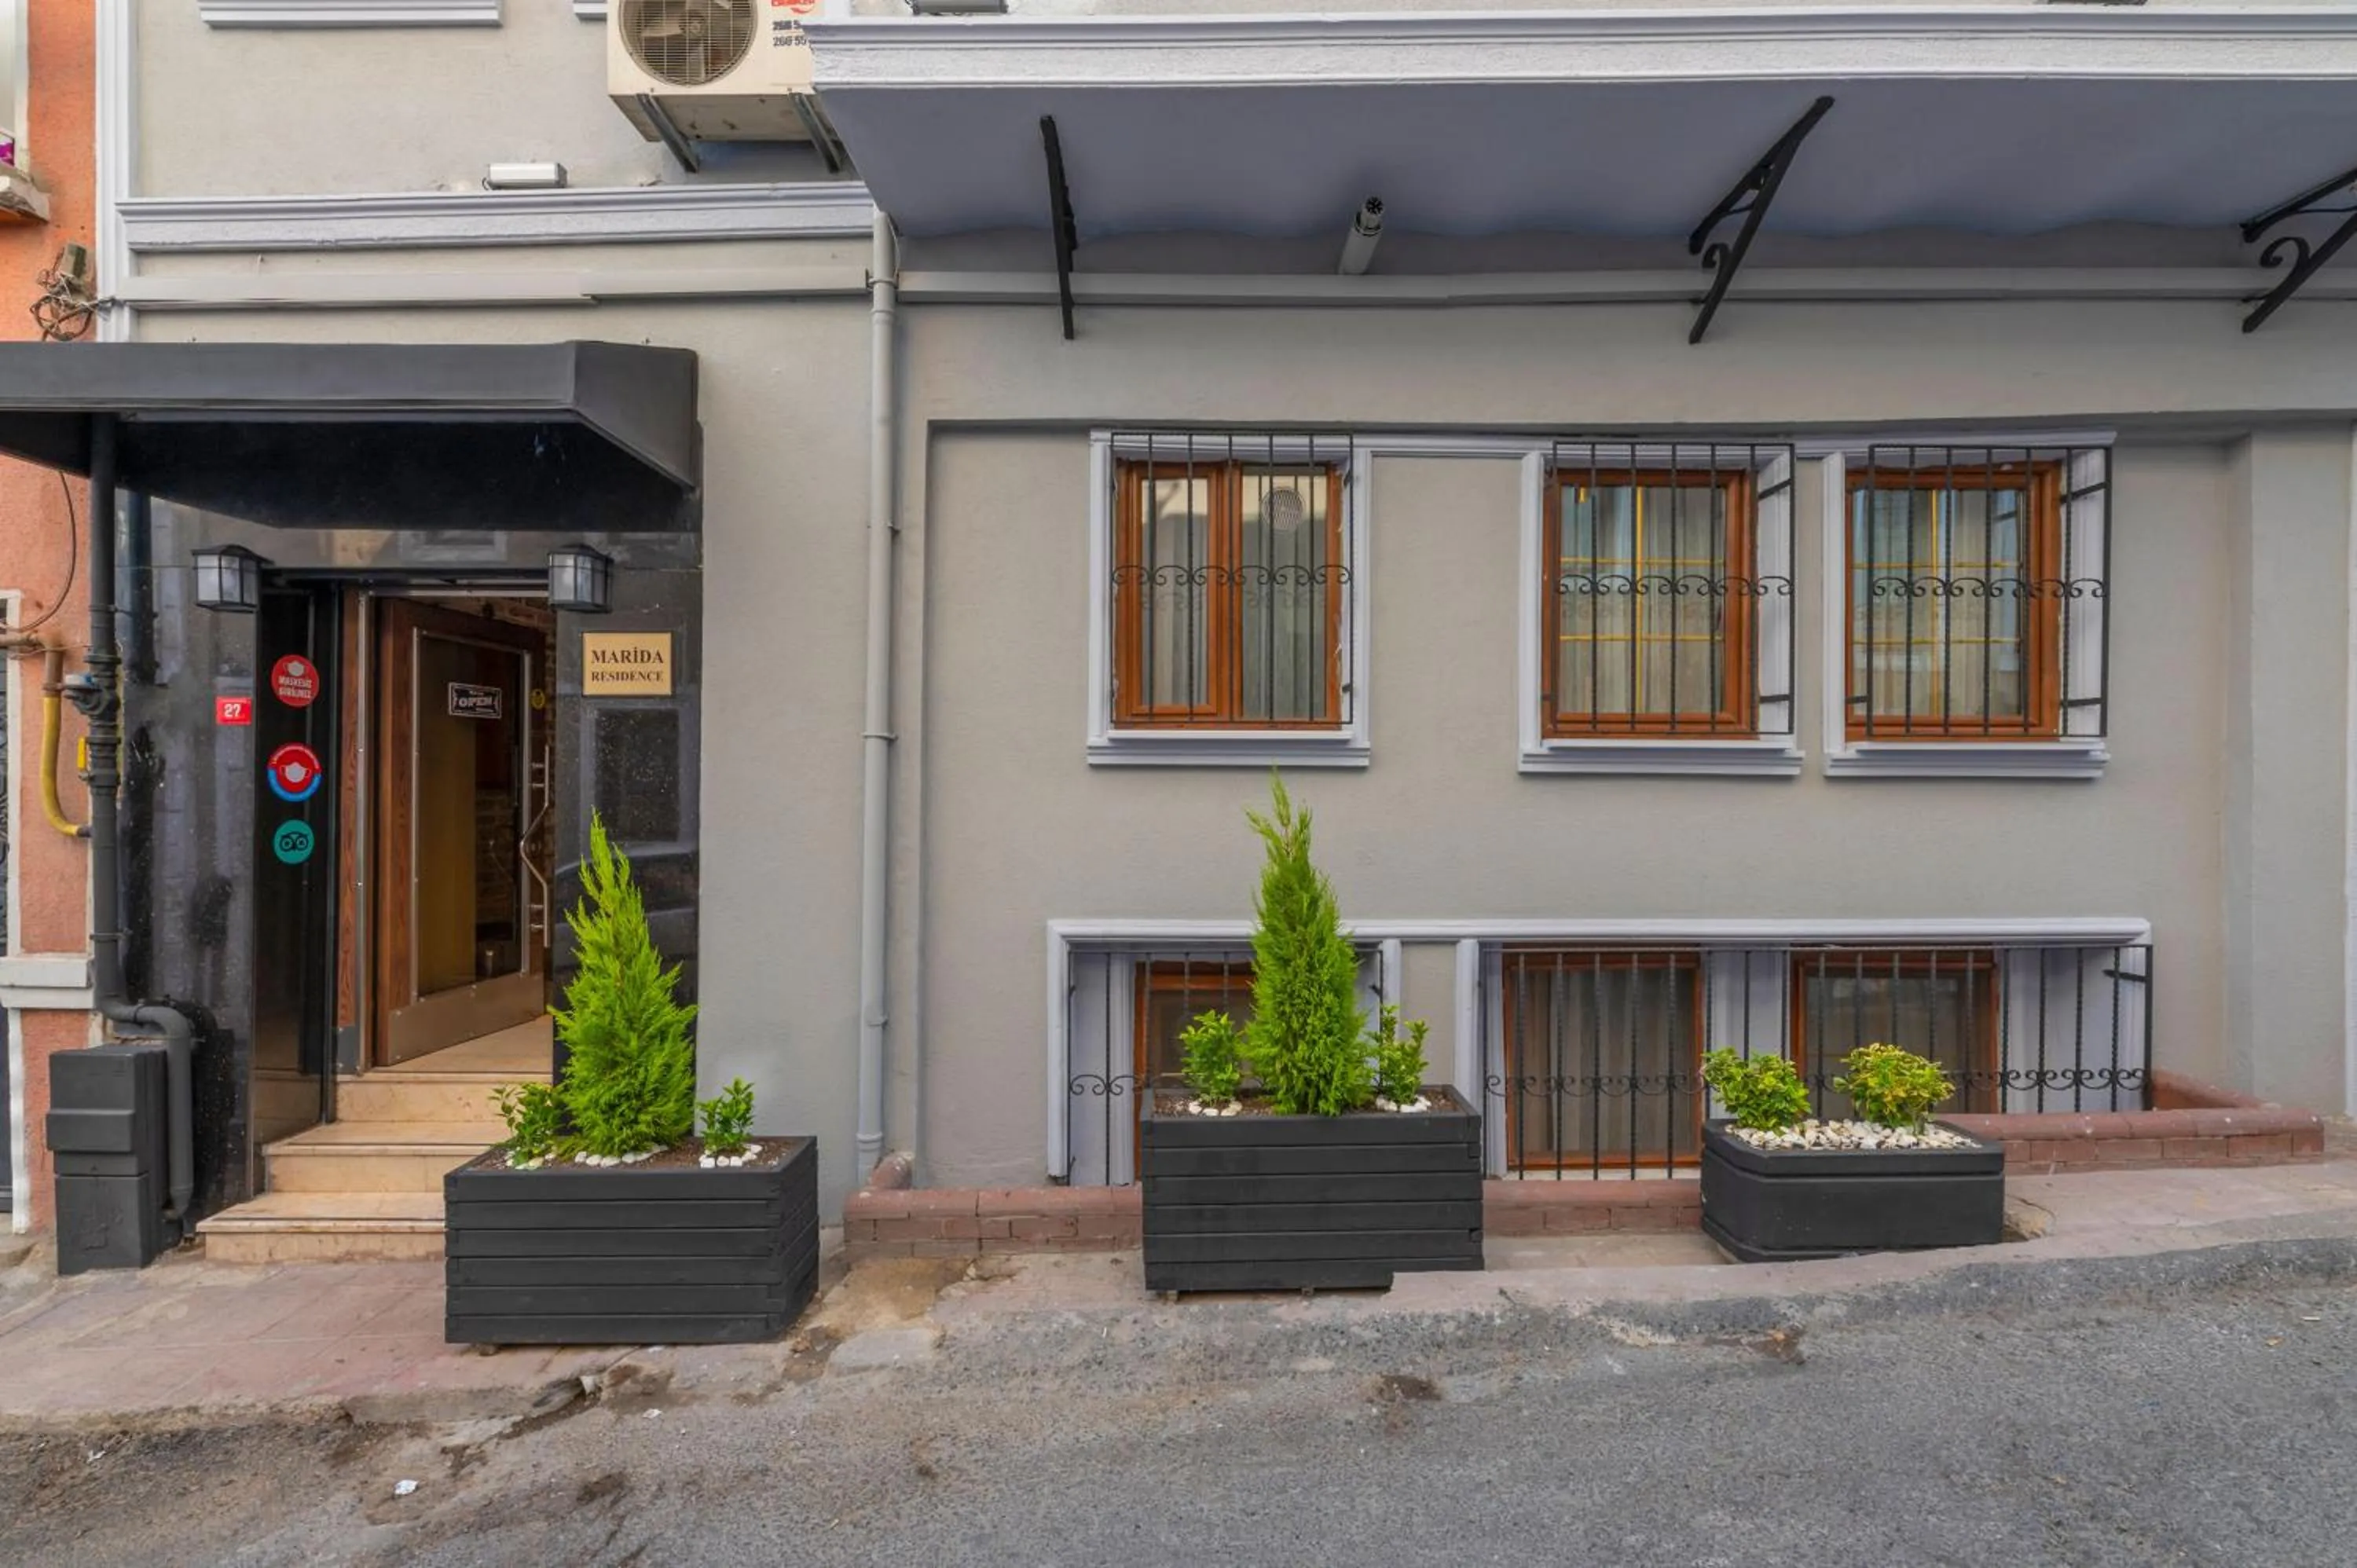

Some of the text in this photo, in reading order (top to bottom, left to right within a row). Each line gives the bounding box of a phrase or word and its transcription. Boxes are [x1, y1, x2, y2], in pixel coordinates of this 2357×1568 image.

[591, 647, 664, 664] MARİDA
[591, 670, 664, 682] RESIDENCE
[224, 703, 241, 717] 27
